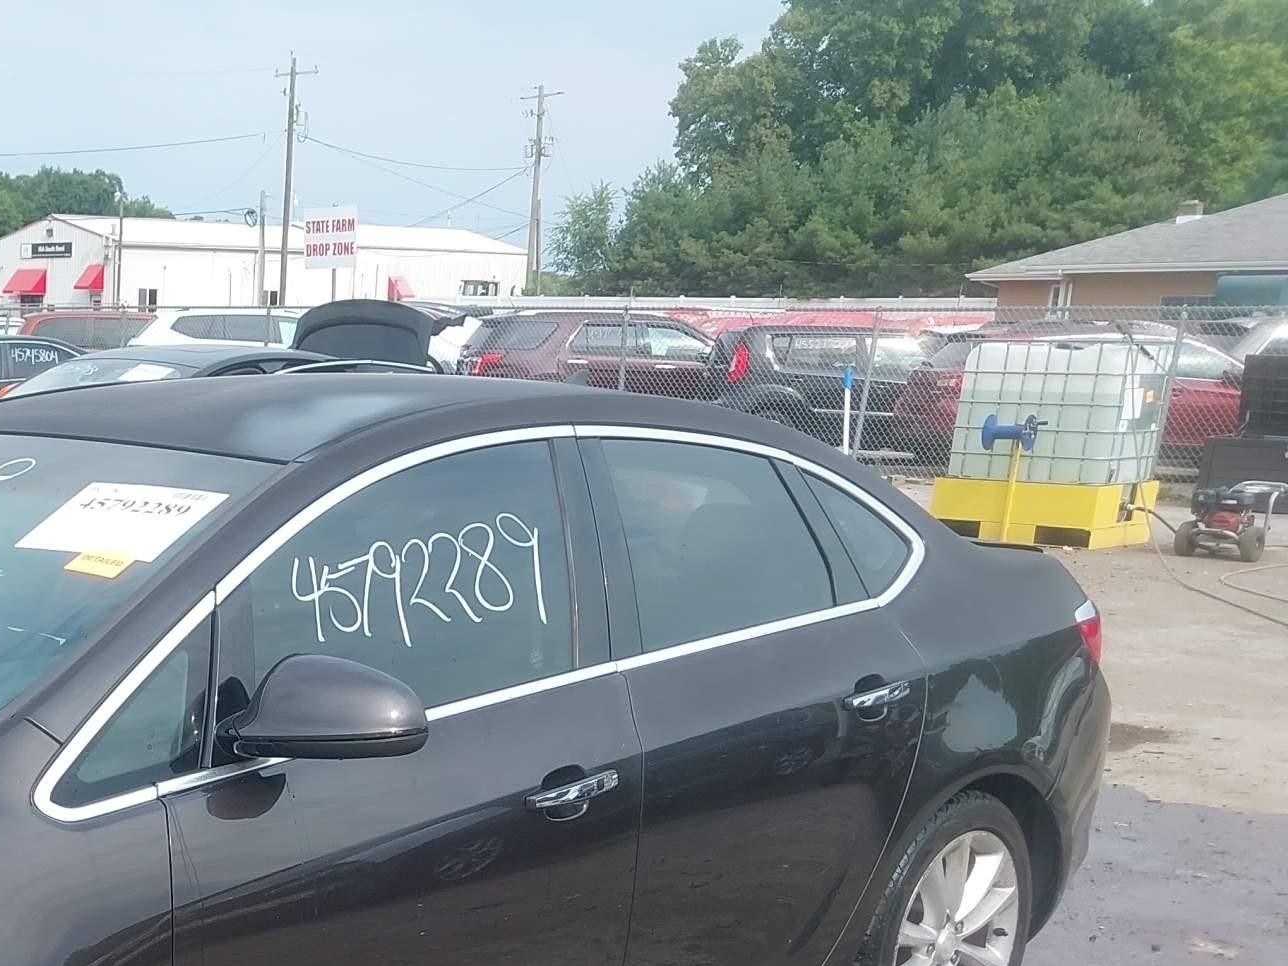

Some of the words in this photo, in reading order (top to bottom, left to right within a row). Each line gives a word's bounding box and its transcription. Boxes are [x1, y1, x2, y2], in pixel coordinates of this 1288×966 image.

[305, 220, 329, 234] STATE
[332, 219, 355, 232] FARM
[306, 243, 330, 257] DROP
[332, 241, 355, 256] ZONE
[80, 497, 191, 516] 45792289
[291, 512, 547, 648] 45792289
